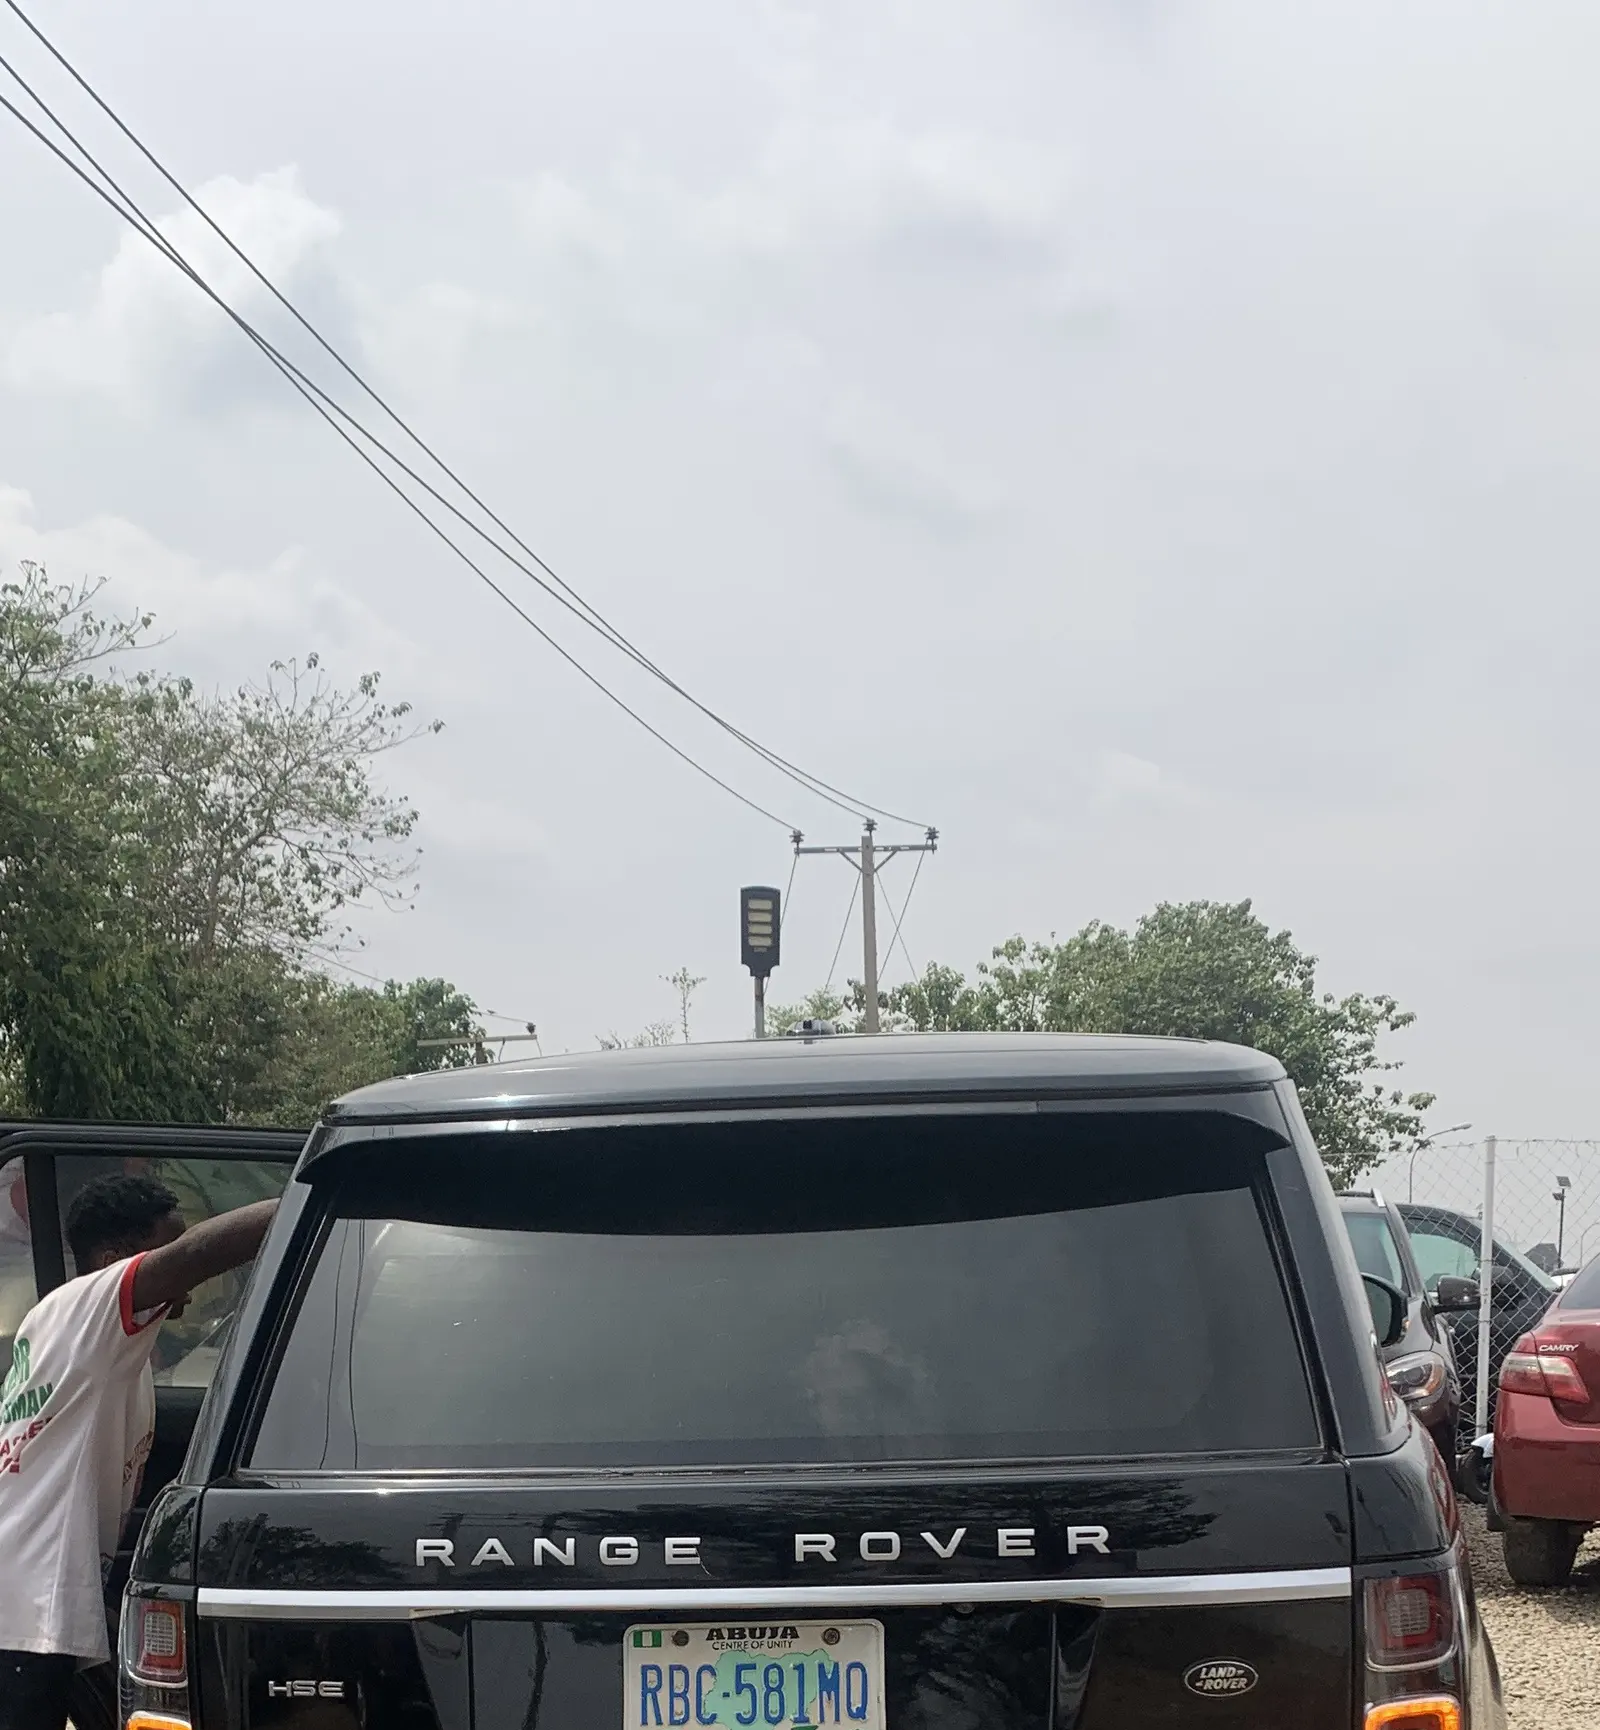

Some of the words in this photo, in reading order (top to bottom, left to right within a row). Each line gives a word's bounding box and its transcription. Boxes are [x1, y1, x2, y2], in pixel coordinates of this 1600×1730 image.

[1539, 1343, 1579, 1352] CAMRY
[415, 1536, 701, 1567] RANGE
[794, 1525, 1111, 1563] ROVER
[705, 1626, 800, 1641] ABUJA
[711, 1641, 748, 1651] CENTRE
[750, 1640, 764, 1650] OF
[767, 1640, 793, 1649] UNITY
[268, 1680, 344, 1698] HSE
[640, 1662, 869, 1727] RBC-581MQ
